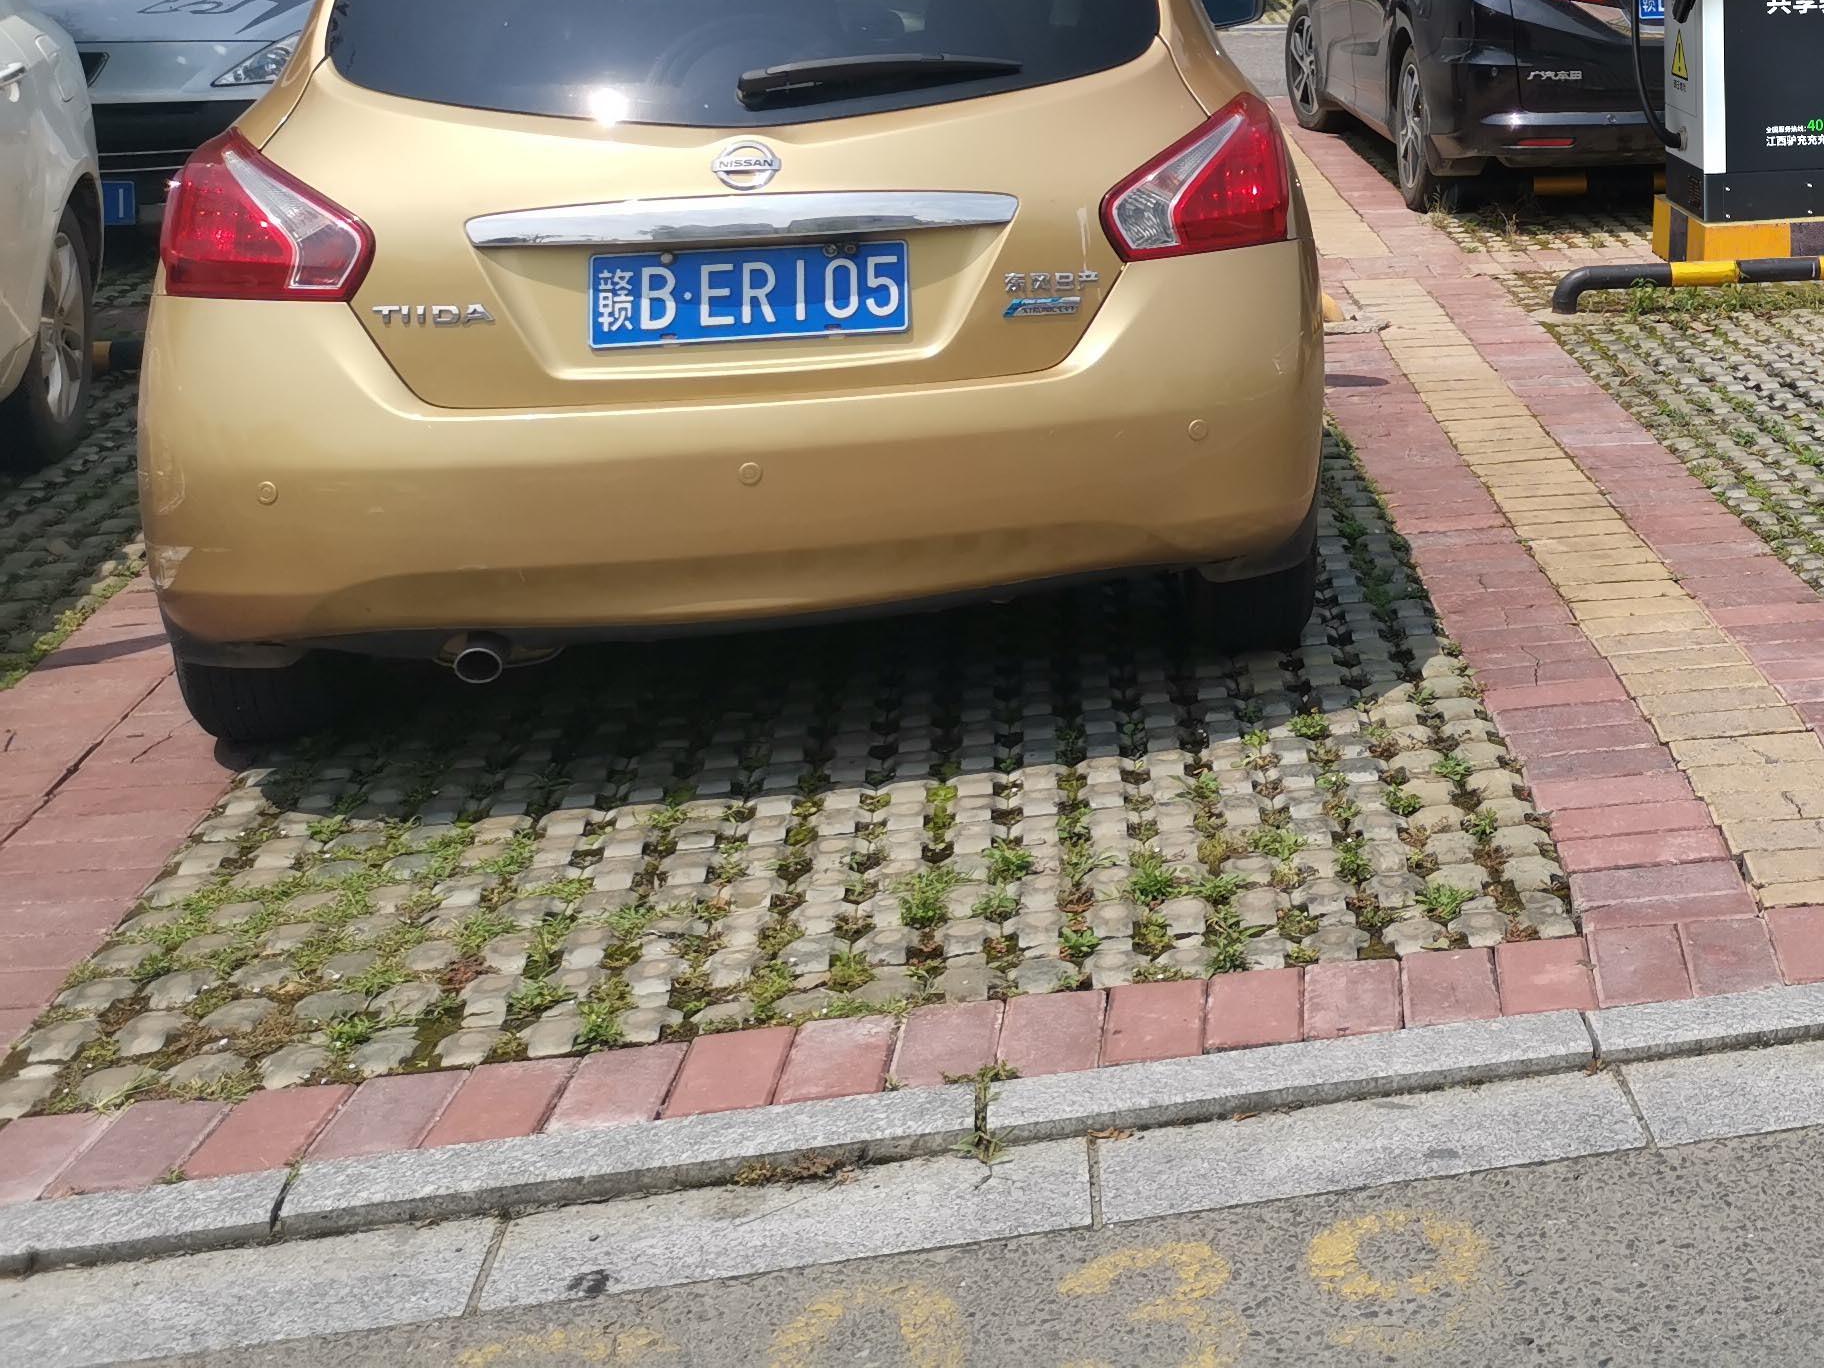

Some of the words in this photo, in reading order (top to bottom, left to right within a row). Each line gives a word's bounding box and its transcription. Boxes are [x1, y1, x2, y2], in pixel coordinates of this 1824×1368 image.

[1526, 70, 1583, 82] 广汽本田
[718, 158, 774, 168] NISSAN
[1004, 270, 1101, 293] 东风日产
[372, 303, 496, 328] TIIDA
